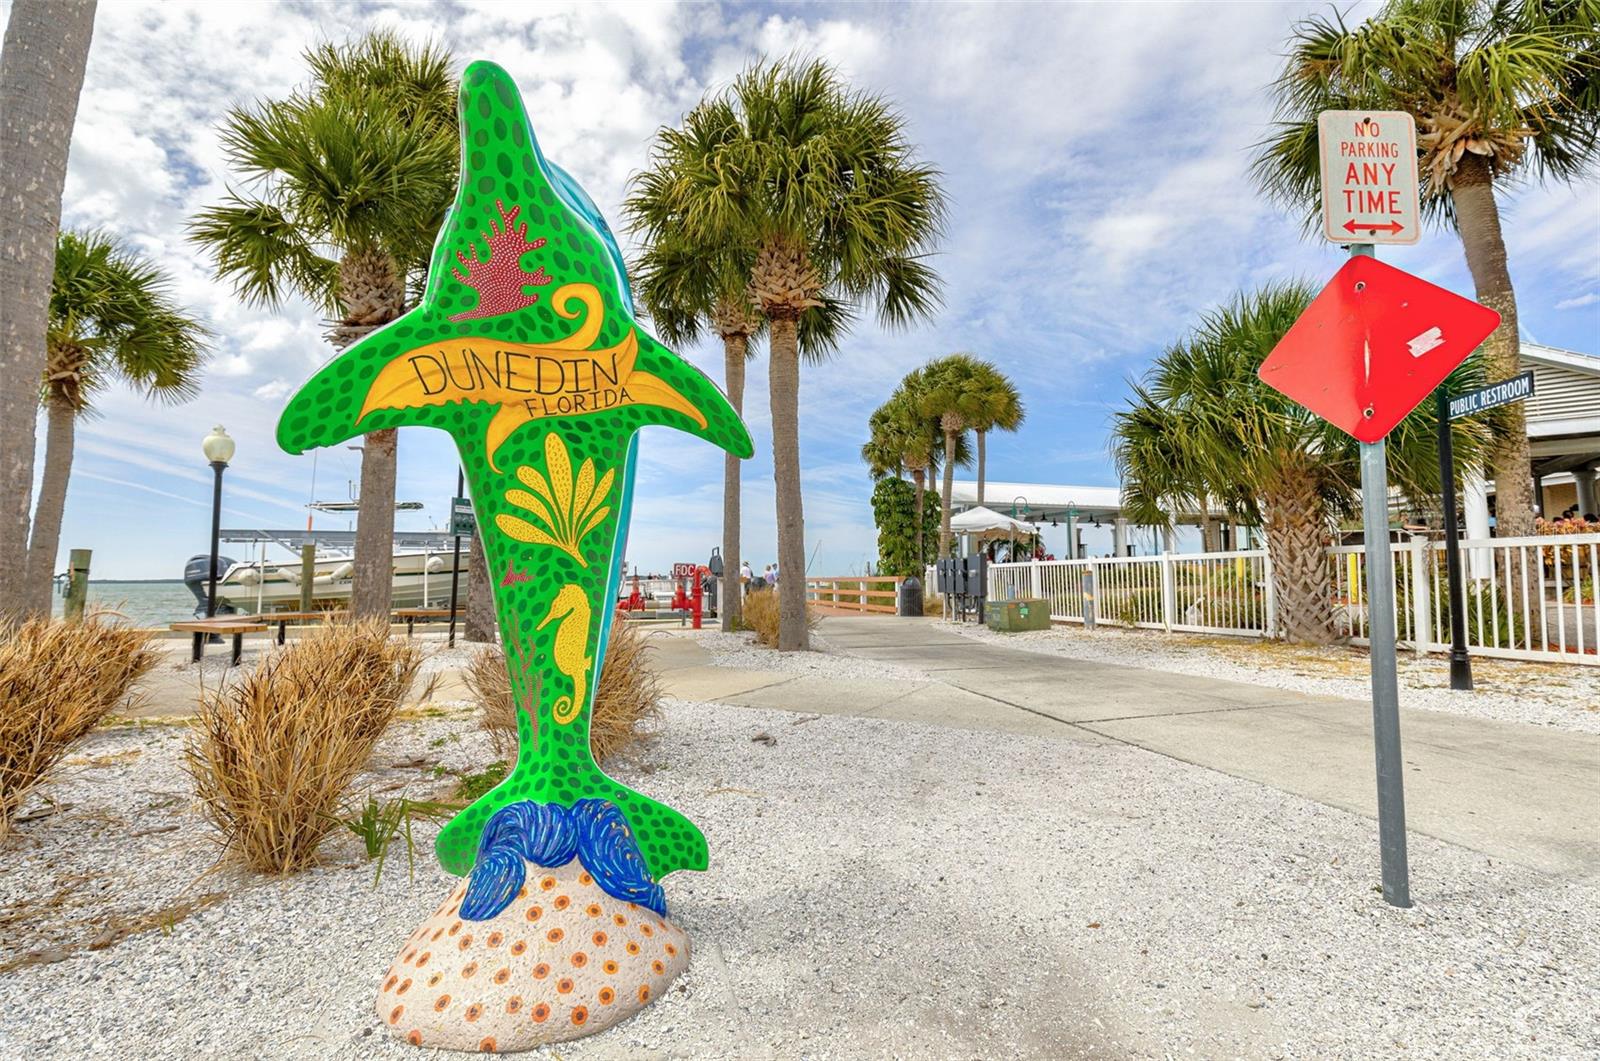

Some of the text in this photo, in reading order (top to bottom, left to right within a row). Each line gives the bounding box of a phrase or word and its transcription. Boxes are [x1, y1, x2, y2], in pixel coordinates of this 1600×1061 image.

[1355, 122, 1380, 137] NO
[1341, 141, 1399, 158] PARKING
[1345, 162, 1396, 186] ANY
[1342, 190, 1402, 214] TIME
[408, 348, 619, 395] DUNEDIN
[523, 386, 636, 417] FLORIDA
[1449, 377, 1529, 416] PUBLIC RESTROOM
[675, 564, 694, 576] FDC
